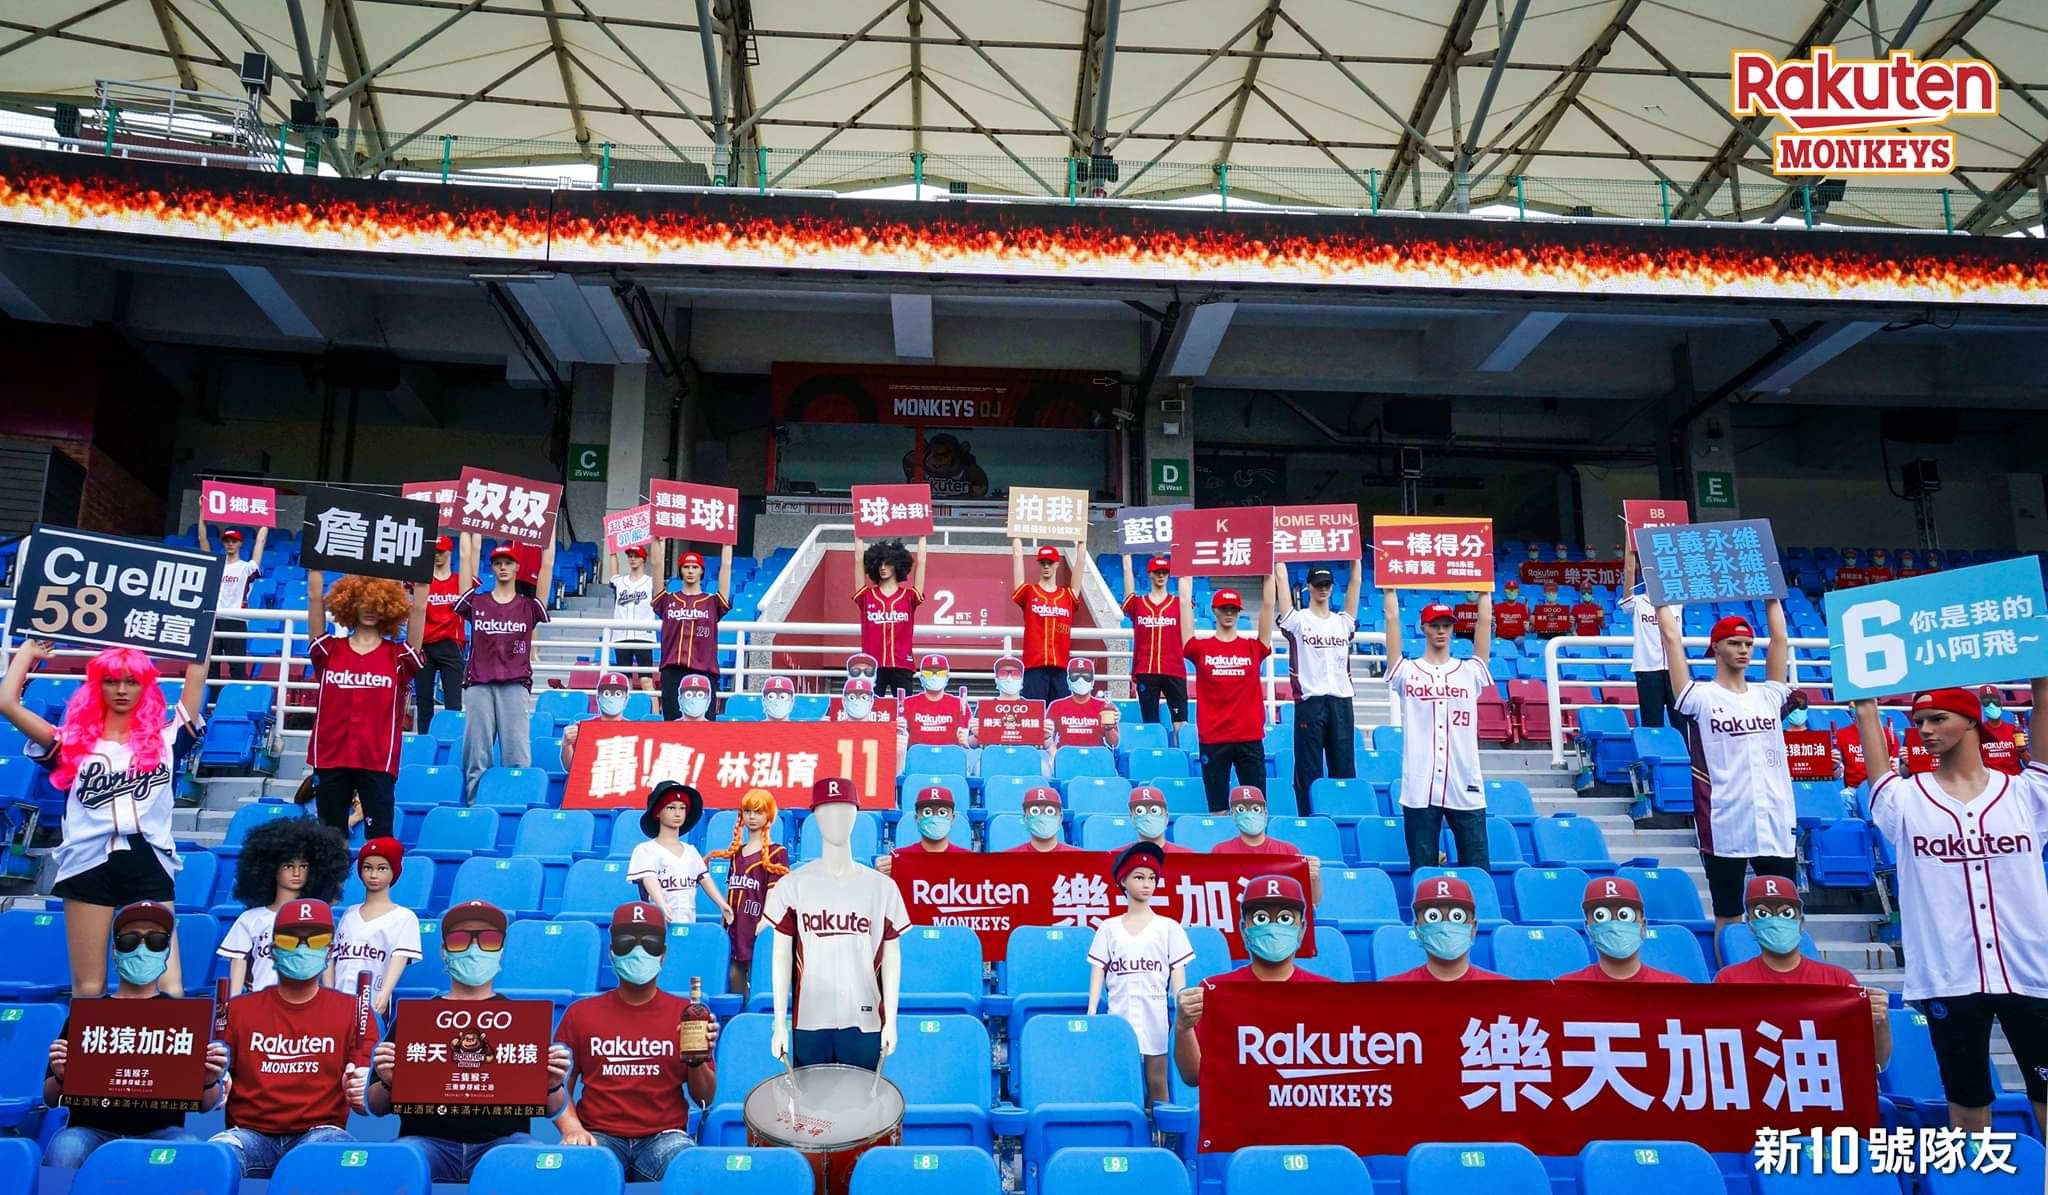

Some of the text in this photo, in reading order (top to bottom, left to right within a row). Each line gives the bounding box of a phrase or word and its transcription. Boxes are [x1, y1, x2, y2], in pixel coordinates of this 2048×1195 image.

[893, 398, 974, 417] MONKEYS
[580, 450, 597, 469] C
[1162, 465, 1178, 483] D
[1708, 478, 1723, 495] E
[229, 496, 269, 516] 鄉長
[462, 478, 550, 528] 奴奴
[655, 492, 687, 510] 這邊
[1015, 494, 1083, 522] 拍我!
[655, 511, 686, 529] 這邊
[690, 498, 735, 531] 球!
[1319, 514, 1353, 526] RUN
[1650, 509, 1665, 519] BB
[1123, 515, 1172, 545] 藍8
[1216, 519, 1229, 533] K
[314, 505, 424, 567] 詹帥
[1272, 529, 1354, 553] 全壘打
[1651, 527, 1761, 556] 見義永維
[1192, 538, 1252, 566] 三振
[1382, 532, 1485, 557] 一棒得分
[1388, 559, 1436, 575] 朱育賢
[1656, 549, 1767, 578] 見義永維
[43, 546, 208, 610] Cue吧
[1661, 573, 1773, 601] 見義永維
[934, 590, 954, 624] 2
[980, 608, 988, 618] G
[1909, 595, 2033, 634] 你是我的
[31, 585, 196, 647] 58 健富
[1137, 615, 1176, 626] Rakuten
[474, 619, 527, 633] Rakuten
[1841, 599, 1909, 689] 6
[1205, 655, 1252, 666] Rakuten
[325, 669, 392, 688] Rakuten
[1406, 684, 1468, 698] Rakuten
[995, 704, 1028, 713] GO GO
[914, 713, 953, 723] Rakuten
[1061, 716, 1099, 726] Rakuten
[1452, 710, 1470, 727] 29
[716, 739, 879, 797] 林泓育 11
[827, 780, 841, 794] R
[931, 788, 940, 798] R
[1037, 788, 1046, 798] R
[1142, 788, 1151, 799] R
[1243, 788, 1251, 798] R
[1913, 833, 2032, 857] Rakuten
[912, 878, 1029, 905] Rakuten
[1267, 880, 1280, 895] R
[1438, 881, 1450, 895] R
[1605, 881, 1617, 895] R
[1765, 880, 1777, 894] R
[299, 904, 312, 918] R
[633, 906, 646, 920] R
[744, 898, 760, 917] 10
[932, 916, 1010, 930] MONKEYS
[8, 1010, 16, 1020] 2
[359, 984, 371, 1035] Rakuten
[436, 1010, 512, 1029] GO GO
[1915, 1015, 1927, 1025] 15
[81, 1025, 194, 1056] 桃猿加油
[250, 1033, 335, 1053] Rakuten
[590, 1036, 674, 1056] Rakuten
[1238, 1023, 1422, 1066] Rakuten
[406, 1042, 447, 1063] 樂天
[495, 1043, 538, 1065] 桃猿
[260, 1061, 319, 1074] MONKEYS
[602, 1063, 660, 1077] MONKEYS
[1460, 1015, 1844, 1113] 樂天加油
[451, 1072, 490, 1082] 三隻猴子
[1268, 1084, 1393, 1107] MONKEYS
[393, 1104, 545, 1116] 禁止酒駕 未滿十八歲禁止飲酒
[158, 1150, 167, 1163] 4
[350, 1152, 359, 1165] 5
[545, 1154, 553, 1166] 6
[735, 1157, 743, 1169] 7
[922, 1156, 930, 1169] 8
[1112, 1158, 1120, 1171] 9
[1289, 1156, 1303, 1168] 10
[1466, 1153, 1479, 1165] 11
[1641, 1150, 1655, 1163] 12
